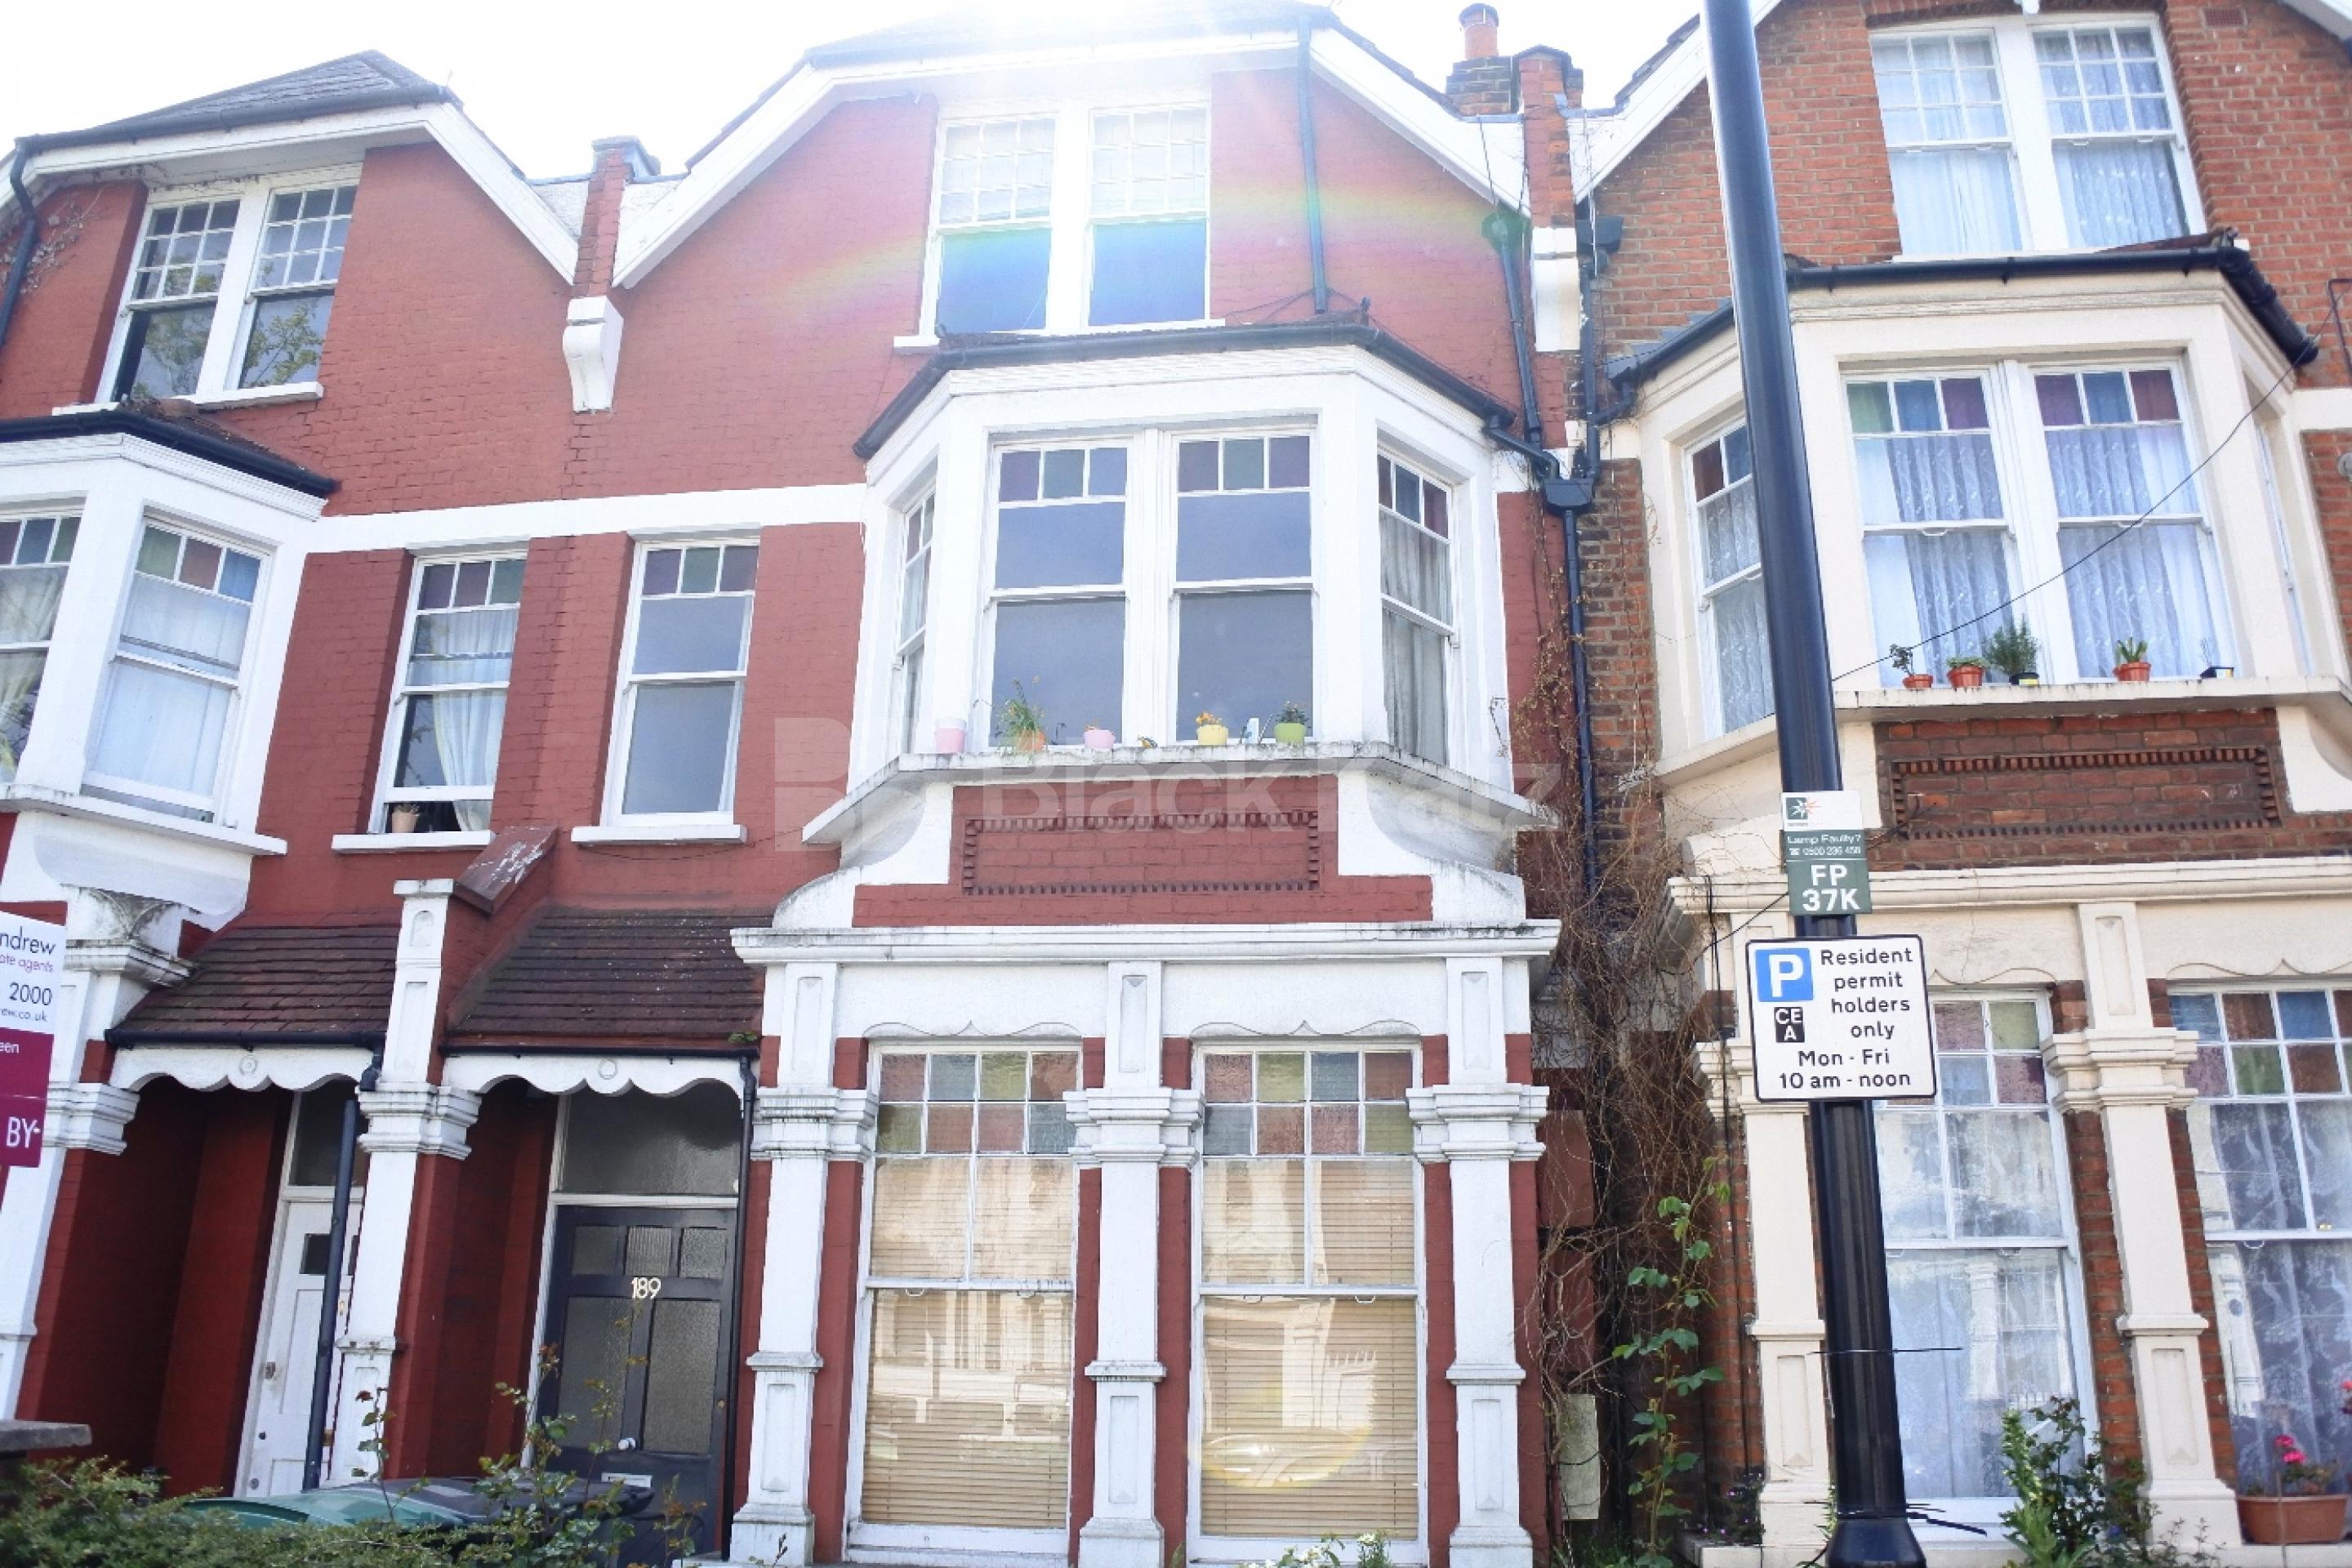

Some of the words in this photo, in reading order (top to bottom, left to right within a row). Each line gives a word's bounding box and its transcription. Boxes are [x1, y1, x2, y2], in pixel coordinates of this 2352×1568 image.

[1788, 836, 1818, 845] Lamp
[1811, 864, 1847, 886] FP
[1802, 888, 1861, 911] 37K
[0, 925, 56, 955] ndrew
[1821, 947, 1913, 965] Resident
[19, 960, 53, 973] agents
[1769, 954, 1803, 998] P
[1834, 971, 1903, 992] permit
[9, 982, 52, 1006] 2000
[1831, 996, 1910, 1014] holders
[1775, 1008, 1802, 1024] CE
[1784, 1025, 1797, 1042] A
[1851, 1021, 1895, 1040] only
[1798, 1050, 1843, 1067] Mon
[1862, 1048, 1890, 1065] Fri
[1780, 1072, 1804, 1089] 10
[1810, 1075, 1841, 1089] am
[1859, 1073, 1911, 1087] noon
[7, 1116, 38, 1147] BY
[630, 1276, 662, 1299] 189
